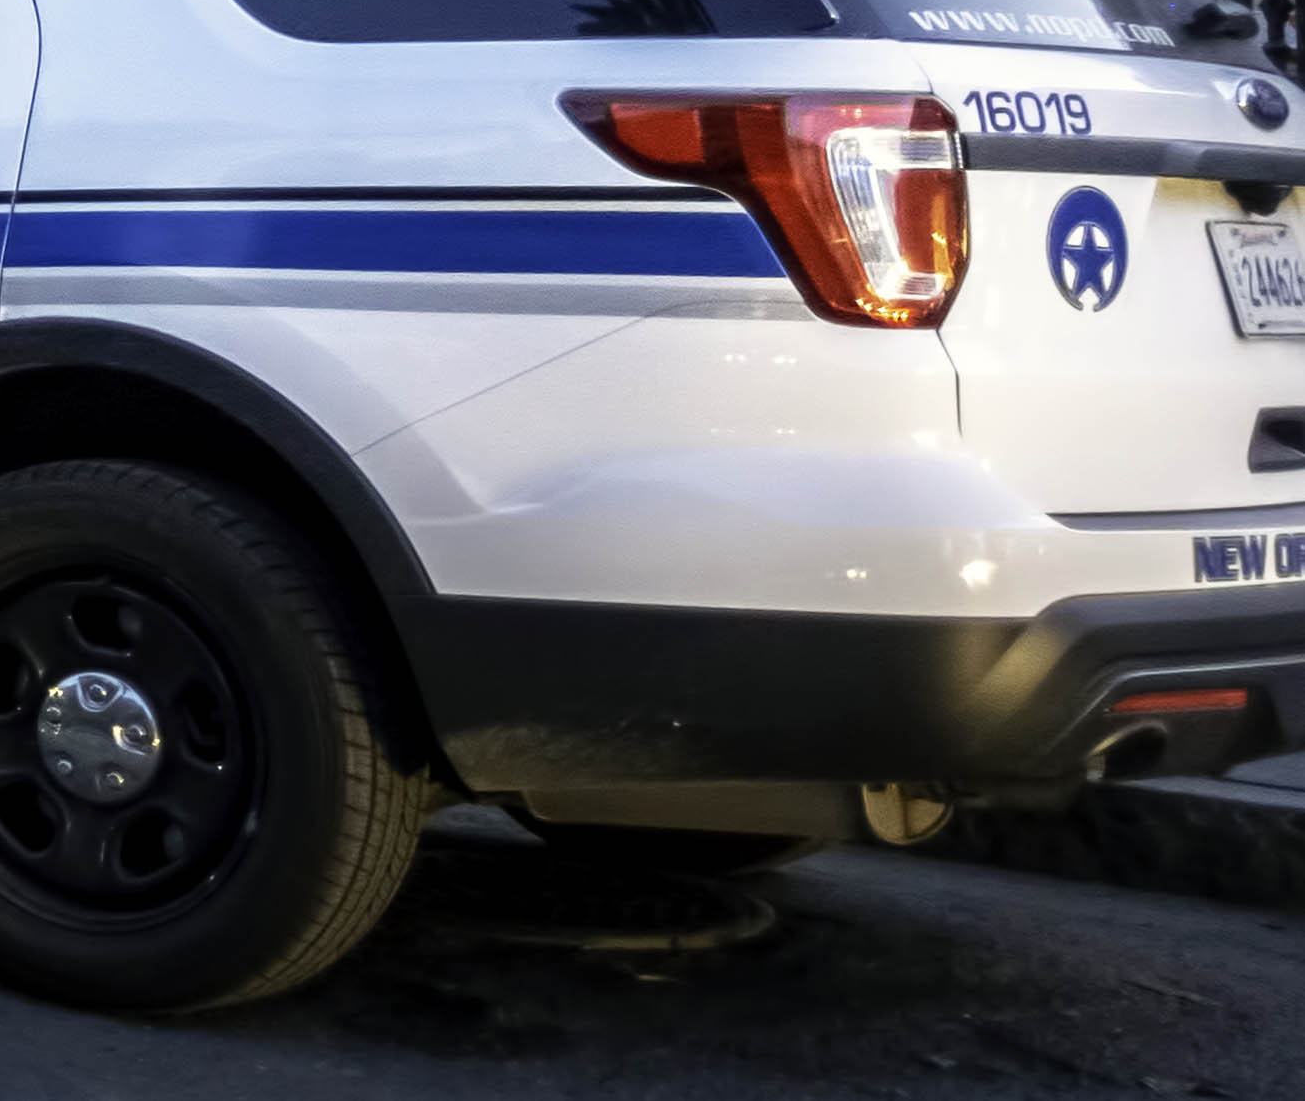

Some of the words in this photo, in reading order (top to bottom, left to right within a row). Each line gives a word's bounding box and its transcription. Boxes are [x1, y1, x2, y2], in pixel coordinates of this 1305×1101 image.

[908, 9, 1176, 48] www.nopd.com
[962, 90, 1092, 136] 16019
[1192, 534, 1267, 583] NEW
